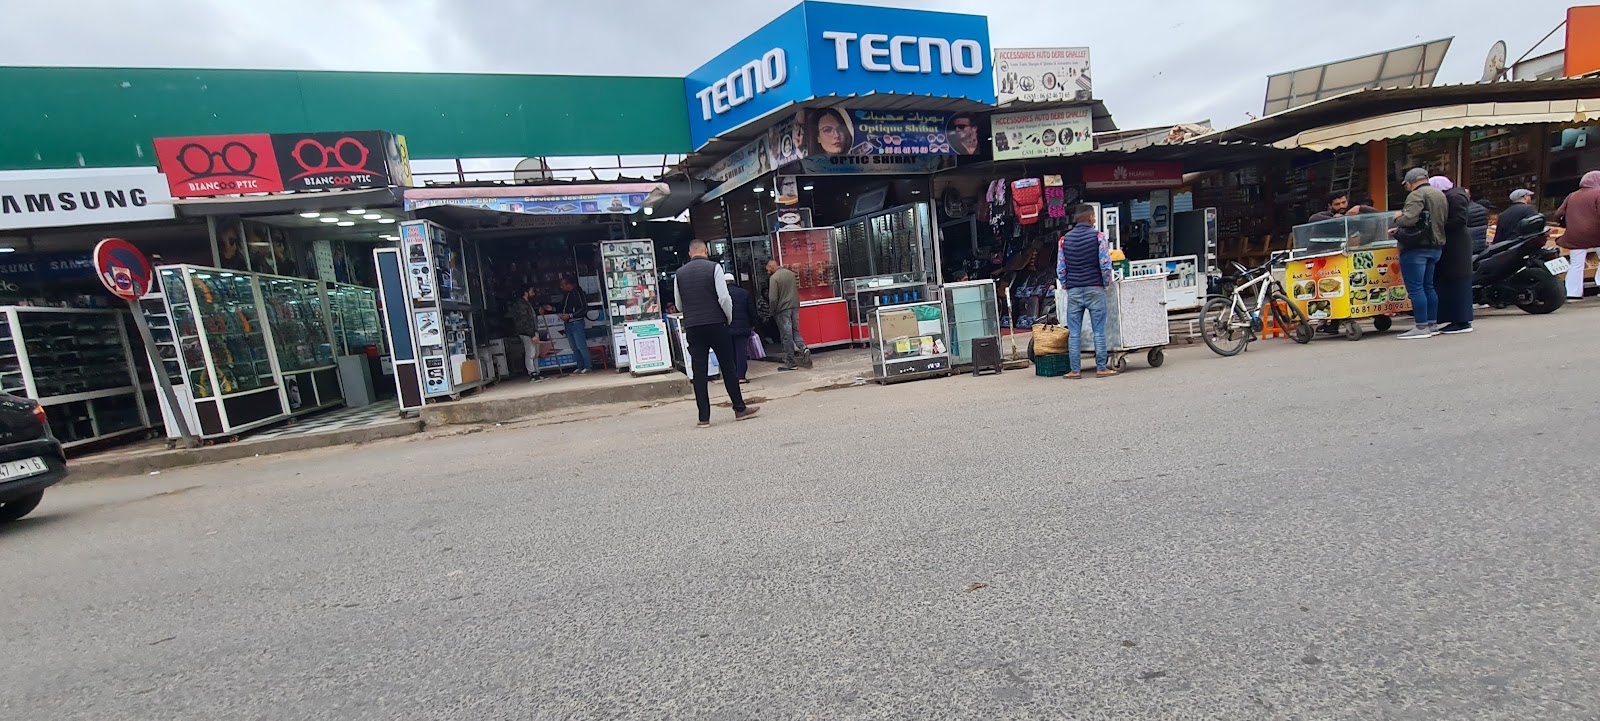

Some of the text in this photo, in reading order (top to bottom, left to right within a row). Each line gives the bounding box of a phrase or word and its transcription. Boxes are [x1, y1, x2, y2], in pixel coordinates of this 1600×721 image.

[822, 31, 983, 75] TECNO
[1000, 51, 1035, 60] ACCESSOIRES
[1037, 51, 1050, 59] AUTO
[1051, 51, 1064, 59] DERB
[695, 47, 787, 121] TECNO
[995, 115, 1034, 126] ACCESSOIRES
[1035, 113, 1050, 121] AUTO
[859, 124, 939, 133] Optique Shibat
[830, 155, 917, 165] OPTIC SHIBAT
[1361, 305, 1370, 313] 81
[1373, 304, 1382, 312] 78
[1384, 303, 1393, 311] 30
[32, 459, 41, 470] 6
